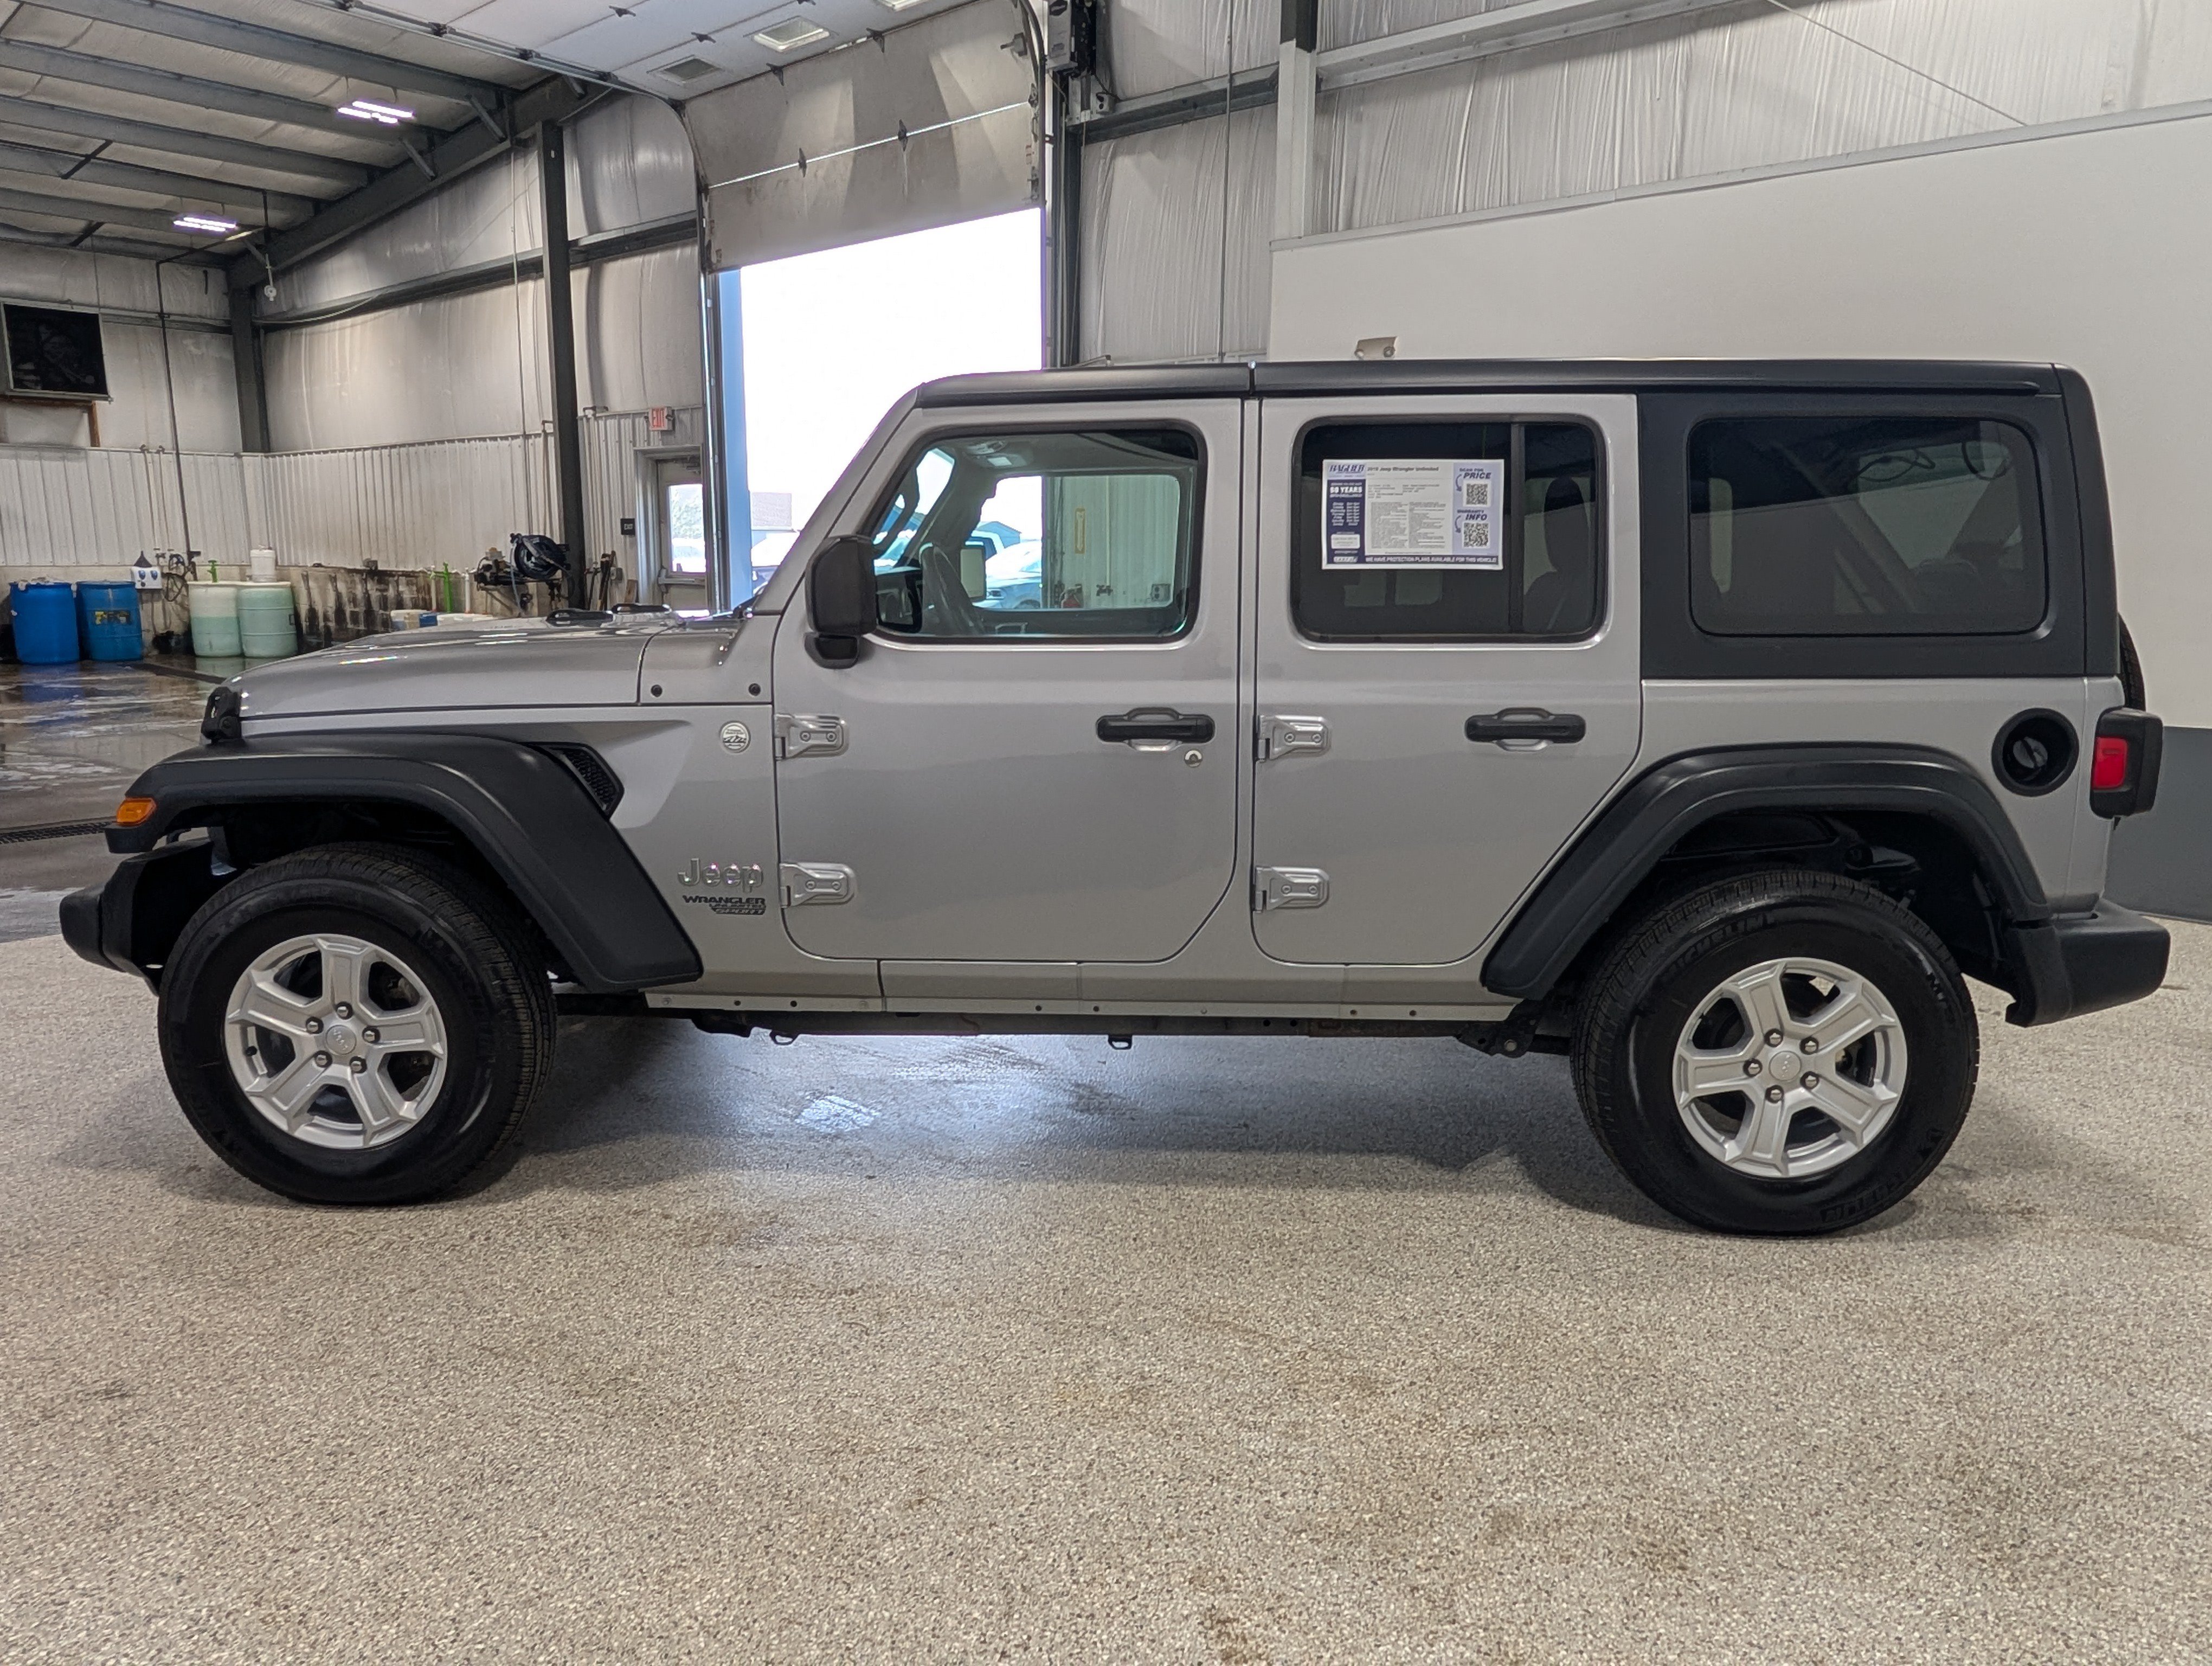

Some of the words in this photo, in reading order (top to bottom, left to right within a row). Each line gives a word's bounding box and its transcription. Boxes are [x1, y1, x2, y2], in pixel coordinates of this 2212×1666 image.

[651, 408, 664, 427] EXIT
[678, 858, 764, 893] Jeep
[683, 895, 766, 905] WRANGLER
